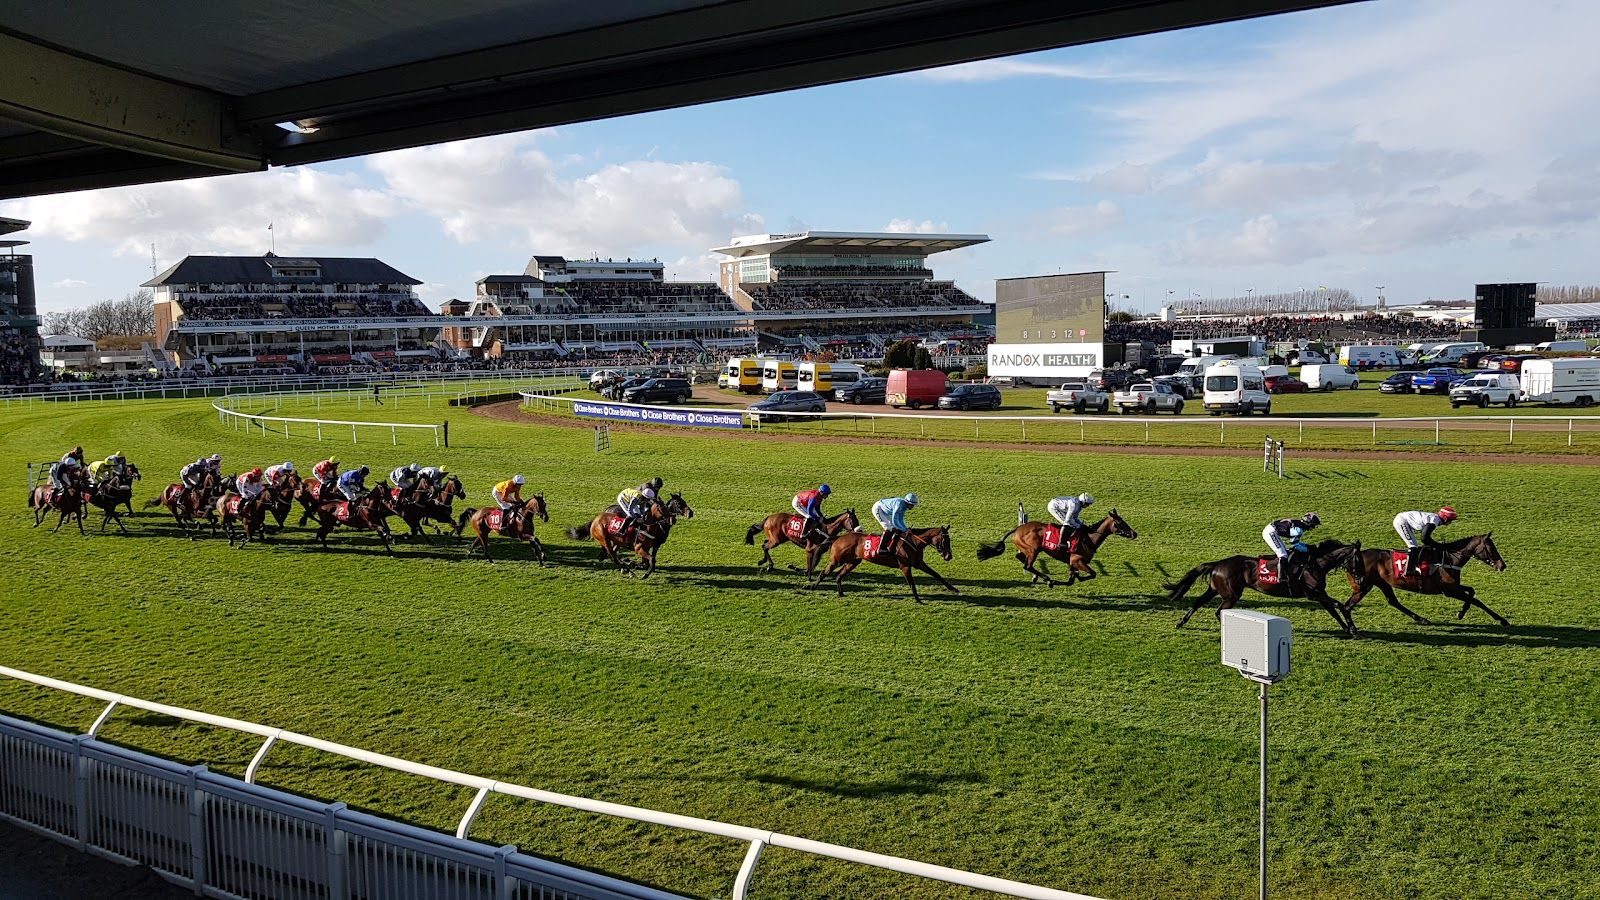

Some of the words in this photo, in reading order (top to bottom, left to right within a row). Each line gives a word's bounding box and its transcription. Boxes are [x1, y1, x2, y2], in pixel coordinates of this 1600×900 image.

[1023, 330, 1028, 339] 8
[1051, 330, 1057, 338] 3
[1064, 329, 1073, 338] 12
[992, 354, 1041, 367] RANDOX
[1048, 355, 1091, 366] HEALTH
[578, 405, 589, 413] Close
[588, 406, 603, 415] Brothers
[608, 408, 620, 416] Close
[619, 408, 640, 418] Brothers
[648, 410, 662, 420] Close
[662, 411, 686, 422] Brothers
[695, 414, 713, 424] Close
[713, 415, 741, 425] Brothers
[490, 515, 500, 524] 10
[790, 519, 801, 531] 16
[1045, 531, 1052, 541] 1
[864, 539, 871, 550] 8
